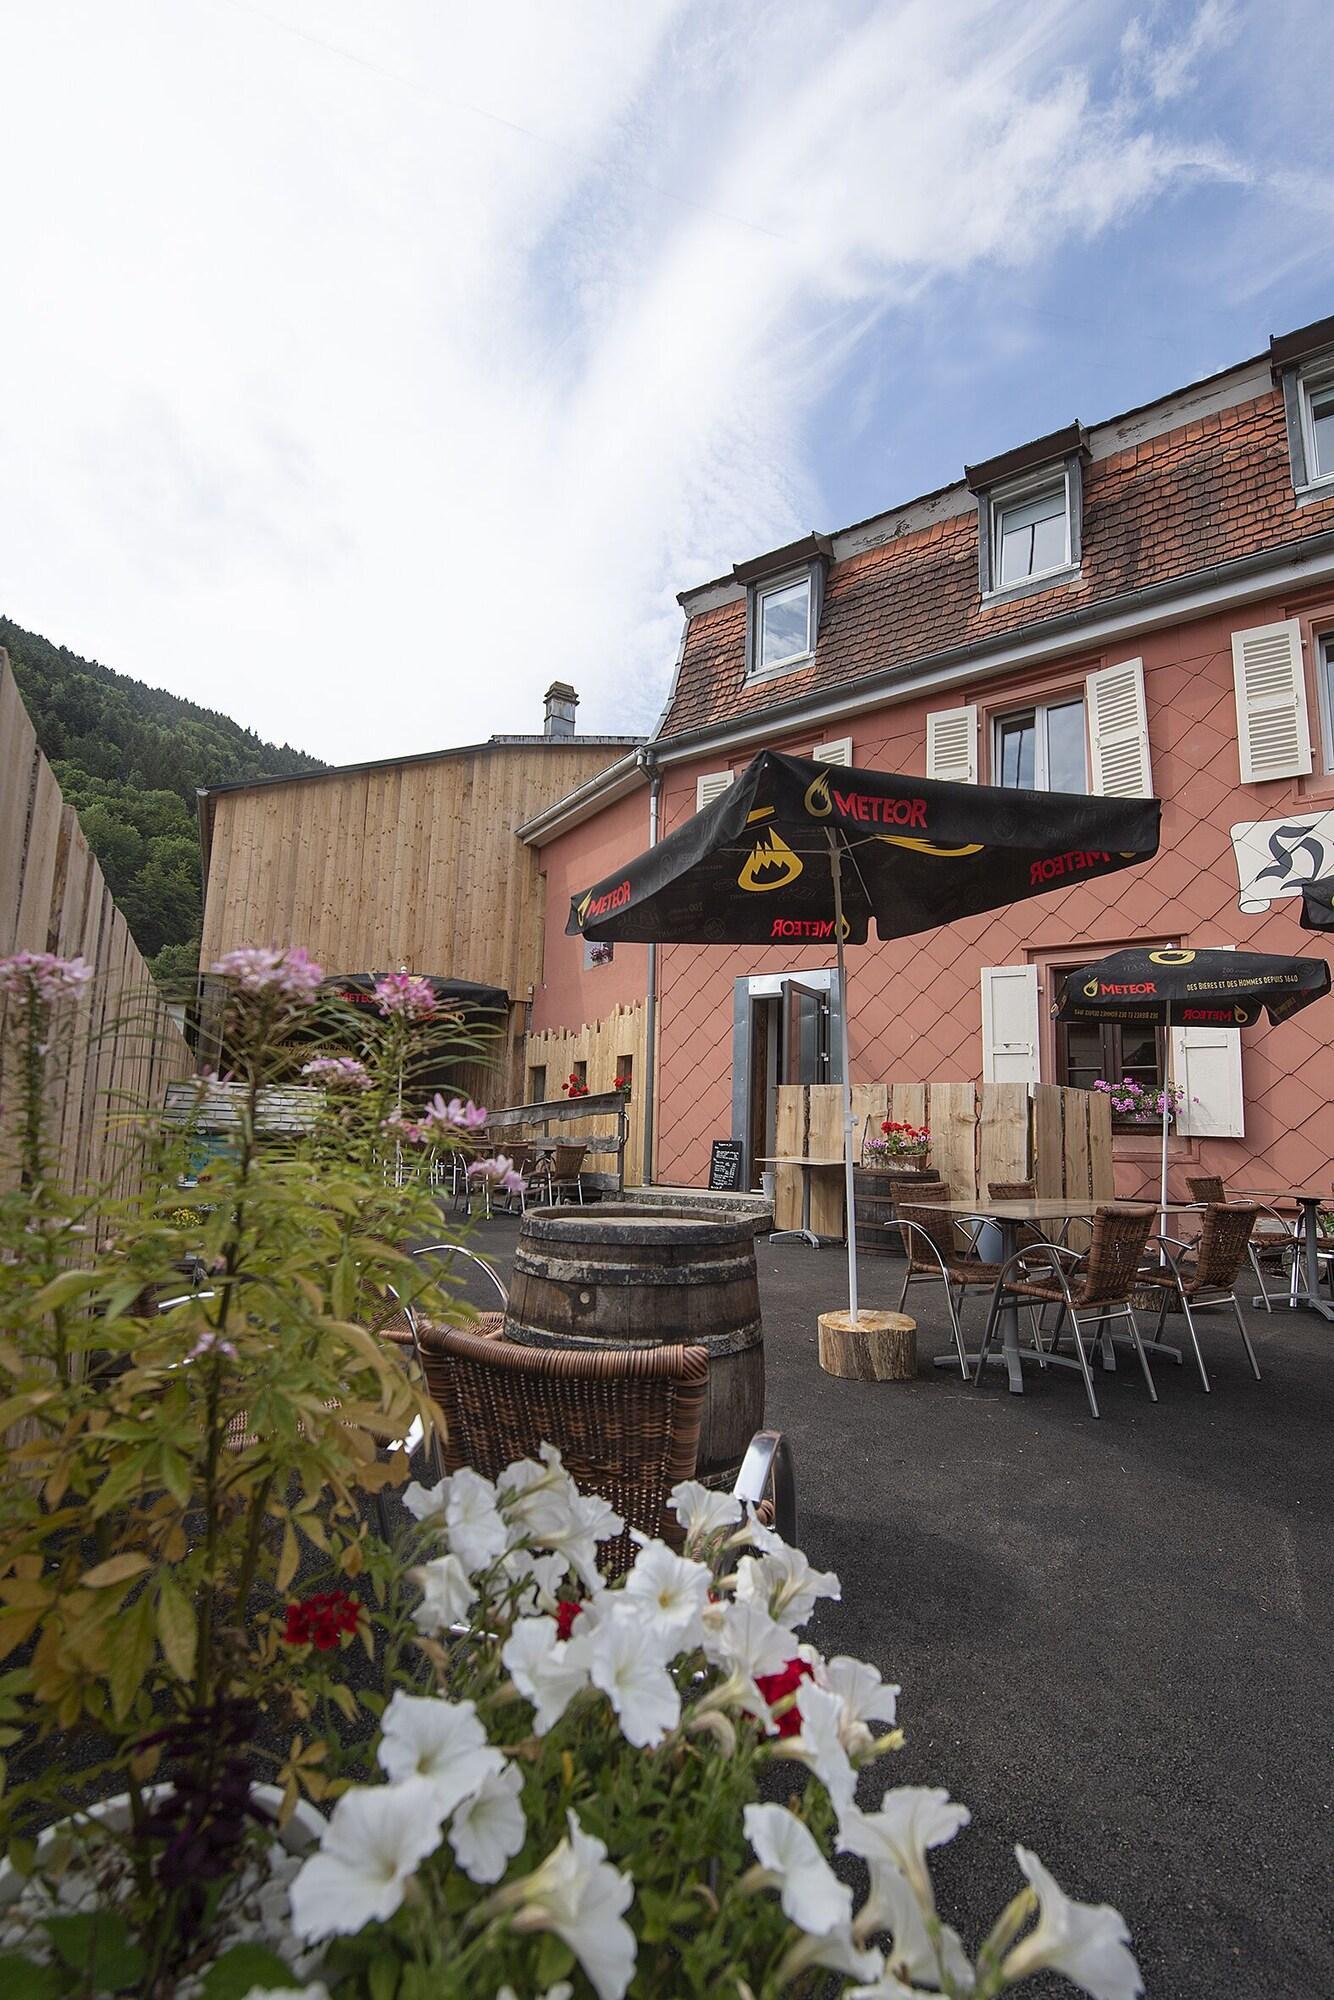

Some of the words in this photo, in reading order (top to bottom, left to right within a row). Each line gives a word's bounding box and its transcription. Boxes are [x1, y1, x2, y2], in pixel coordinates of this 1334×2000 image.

[832, 790, 928, 829] METEOR
[586, 880, 631, 918] METEOR
[1100, 982, 1157, 995] METEOR
